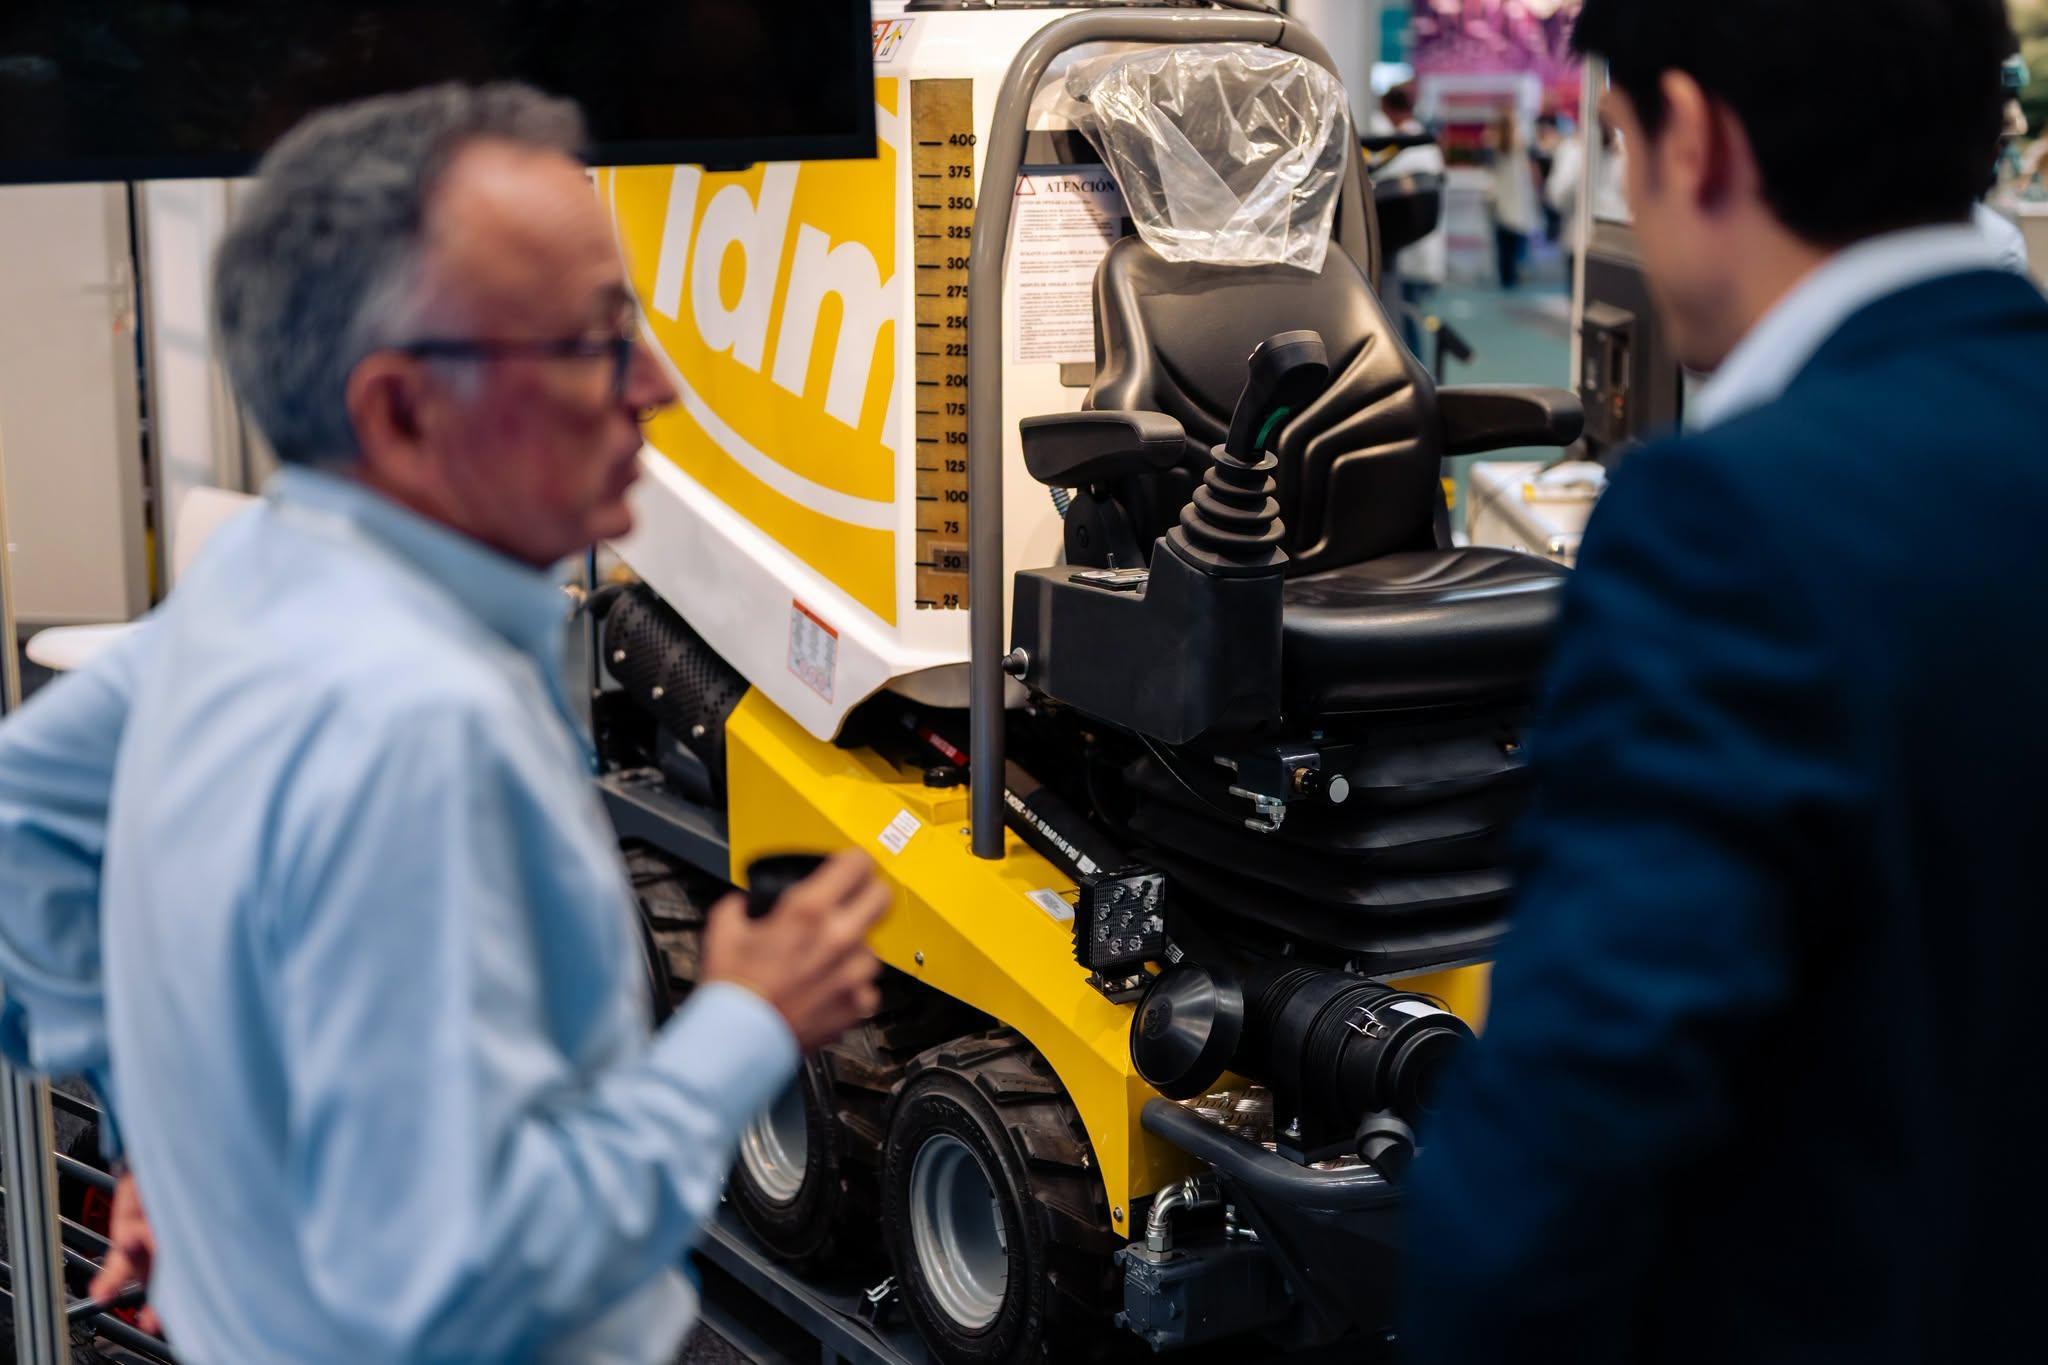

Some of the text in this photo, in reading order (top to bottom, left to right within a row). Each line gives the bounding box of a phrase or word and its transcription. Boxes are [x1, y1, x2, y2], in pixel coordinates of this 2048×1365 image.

[949, 133, 977, 147] 400
[948, 165, 971, 178] 375
[1046, 178, 1115, 193] ATENCIÓN
[948, 197, 973, 210] 350
[947, 226, 972, 239] 325
[946, 286, 968, 298] 275
[945, 403, 966, 416] 175
[945, 432, 968, 445] 150
[944, 460, 966, 473] 125
[944, 490, 969, 503] 100
[943, 521, 959, 534] 75
[943, 556, 960, 569] 50
[943, 594, 959, 607] 25
